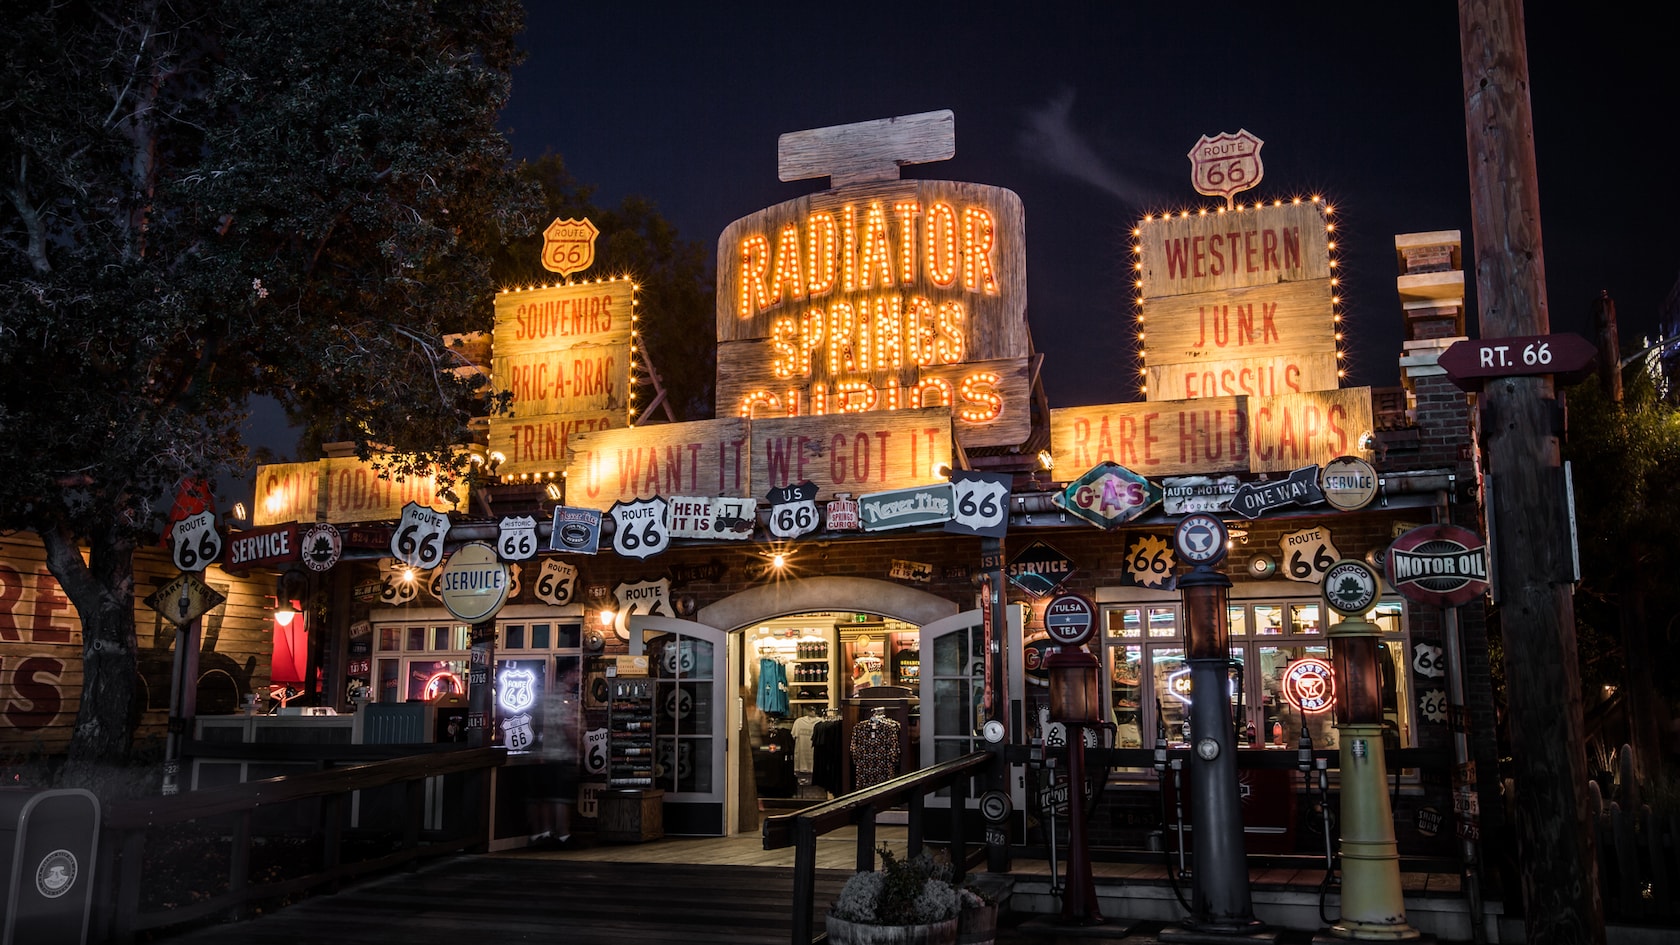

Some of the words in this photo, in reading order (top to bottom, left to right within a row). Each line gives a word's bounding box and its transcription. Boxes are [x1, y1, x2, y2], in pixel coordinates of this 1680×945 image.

[1203, 141, 1245, 157] ROUTE
[1206, 160, 1245, 185] 66
[554, 228, 585, 238] ROUTE
[552, 244, 581, 264] 66
[740, 201, 999, 320] RADIATOR
[1165, 226, 1301, 280] WESTERN
[516, 294, 612, 340] SOUVENIRS
[1192, 302, 1280, 348] JUNK
[773, 297, 965, 379] SPRINGS
[1479, 346, 1513, 368] RT.
[1522, 342, 1553, 366] 66
[511, 356, 614, 402] BRIC-A-BRAC
[1073, 412, 1159, 468] RARE
[586, 450, 601, 499] U
[617, 442, 701, 498] WANT
[719, 438, 744, 490] IT
[766, 435, 812, 487] WE
[829, 431, 891, 485] GOT
[910, 427, 940, 478] IT
[1325, 475, 1371, 489] SERVICE
[783, 487, 803, 501] US
[1244, 490, 1275, 509] ONE
[1276, 479, 1308, 500] WAY
[673, 503, 711, 516] HERE
[828, 501, 858, 513] RADIATOR
[865, 500, 914, 523] Never
[914, 492, 949, 515] Tire
[958, 490, 998, 518] 66
[412, 509, 443, 528] ROUTE
[622, 507, 655, 521] ROUTE
[777, 506, 811, 531] 66
[832, 512, 854, 522] SPRINGS
[179, 516, 207, 534] ROUTE
[307, 523, 339, 538] DINOCO
[672, 518, 688, 530] IT
[694, 518, 710, 531] IS
[828, 521, 857, 529] CURIOS
[1182, 518, 1217, 532] BUTTE
[622, 519, 661, 550] 66
[1288, 531, 1322, 546] ROUTE
[180, 529, 217, 568] 66
[231, 530, 290, 564] SERVICE
[398, 525, 439, 564] 66
[504, 536, 531, 555] 66
[303, 551, 340, 571] GASOLINE
[1134, 547, 1167, 573] 66
[1188, 551, 1211, 560] GAS
[1290, 543, 1335, 578] 66
[548, 563, 572, 575] ROUTE
[1010, 559, 1069, 577] SERVICE
[1331, 566, 1368, 579] DINOCO
[1396, 555, 1456, 578] MOTOR
[1458, 552, 1486, 576] OIL
[445, 570, 501, 590] SERVICE
[538, 574, 570, 600] 66
[153, 581, 182, 606] SPARK
[190, 580, 216, 603] PLUGS
[626, 586, 662, 600] ROUTE
[1328, 590, 1372, 609] GASOLINE
[1055, 603, 1082, 612] TULSA
[1059, 626, 1077, 635] TEA
[669, 654, 690, 669] 66
[1418, 651, 1444, 669] 66
[508, 680, 528, 688] ROUTE
[505, 688, 528, 705] 66
[667, 696, 690, 710] 66
[1425, 697, 1446, 714] 66
[511, 733, 527, 747] 66
[584, 801, 596, 812] IT
[1417, 809, 1442, 825] SHINY
[1418, 819, 1439, 833] WAX
